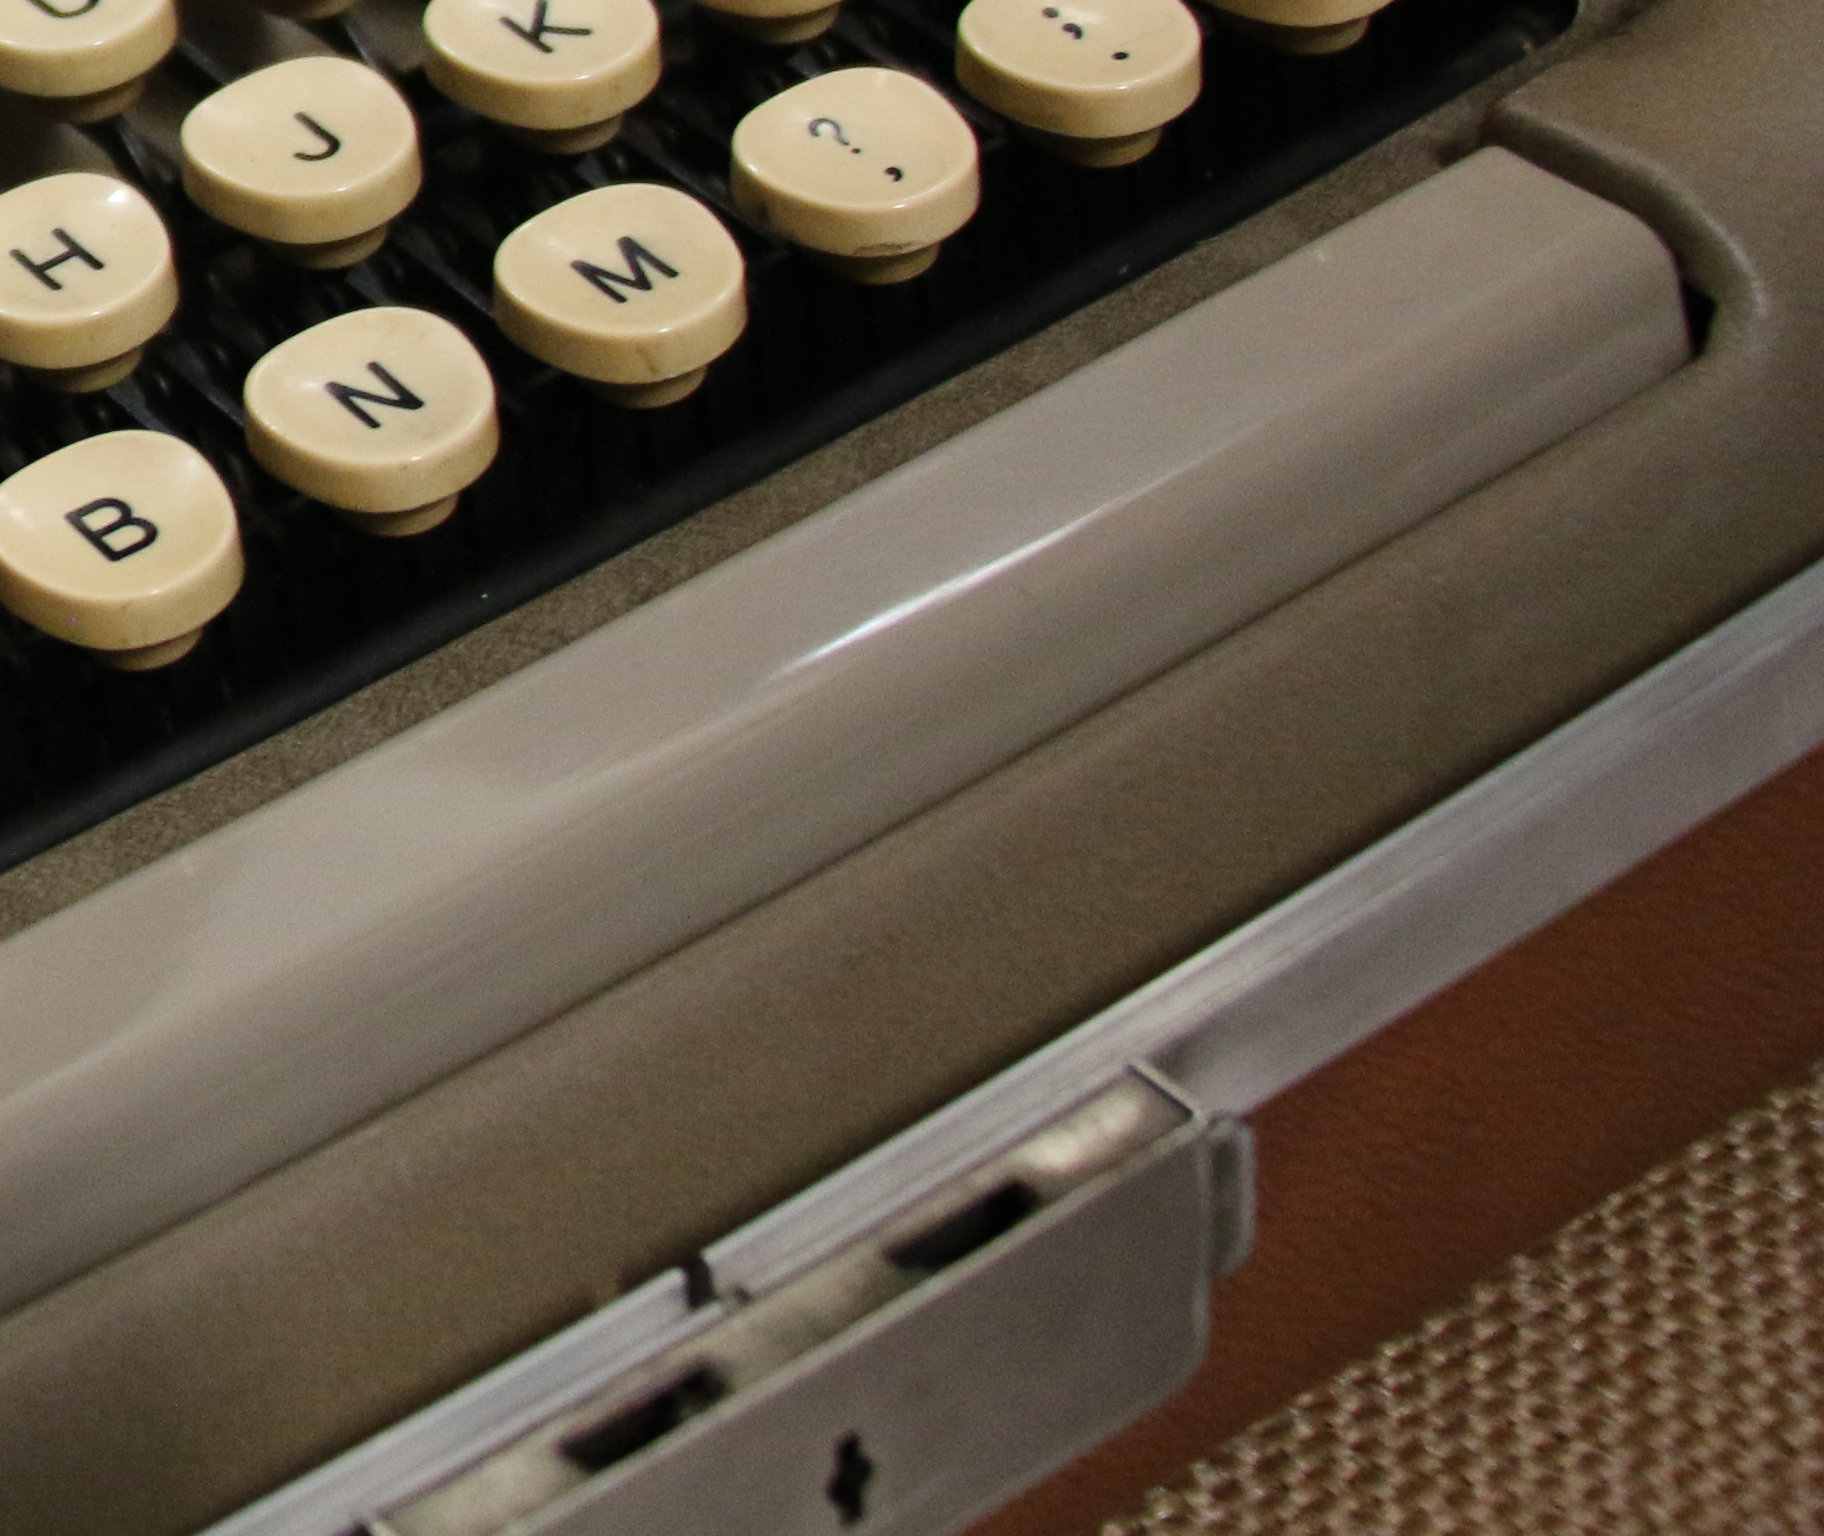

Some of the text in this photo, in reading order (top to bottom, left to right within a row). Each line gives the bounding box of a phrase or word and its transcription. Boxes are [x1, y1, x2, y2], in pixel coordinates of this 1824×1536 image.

[293, 112, 342, 162] J
[807, 117, 864, 156] ?
[11, 228, 106, 291] H
[571, 236, 680, 304] M
[327, 361, 425, 430] N
[66, 497, 159, 563] B
